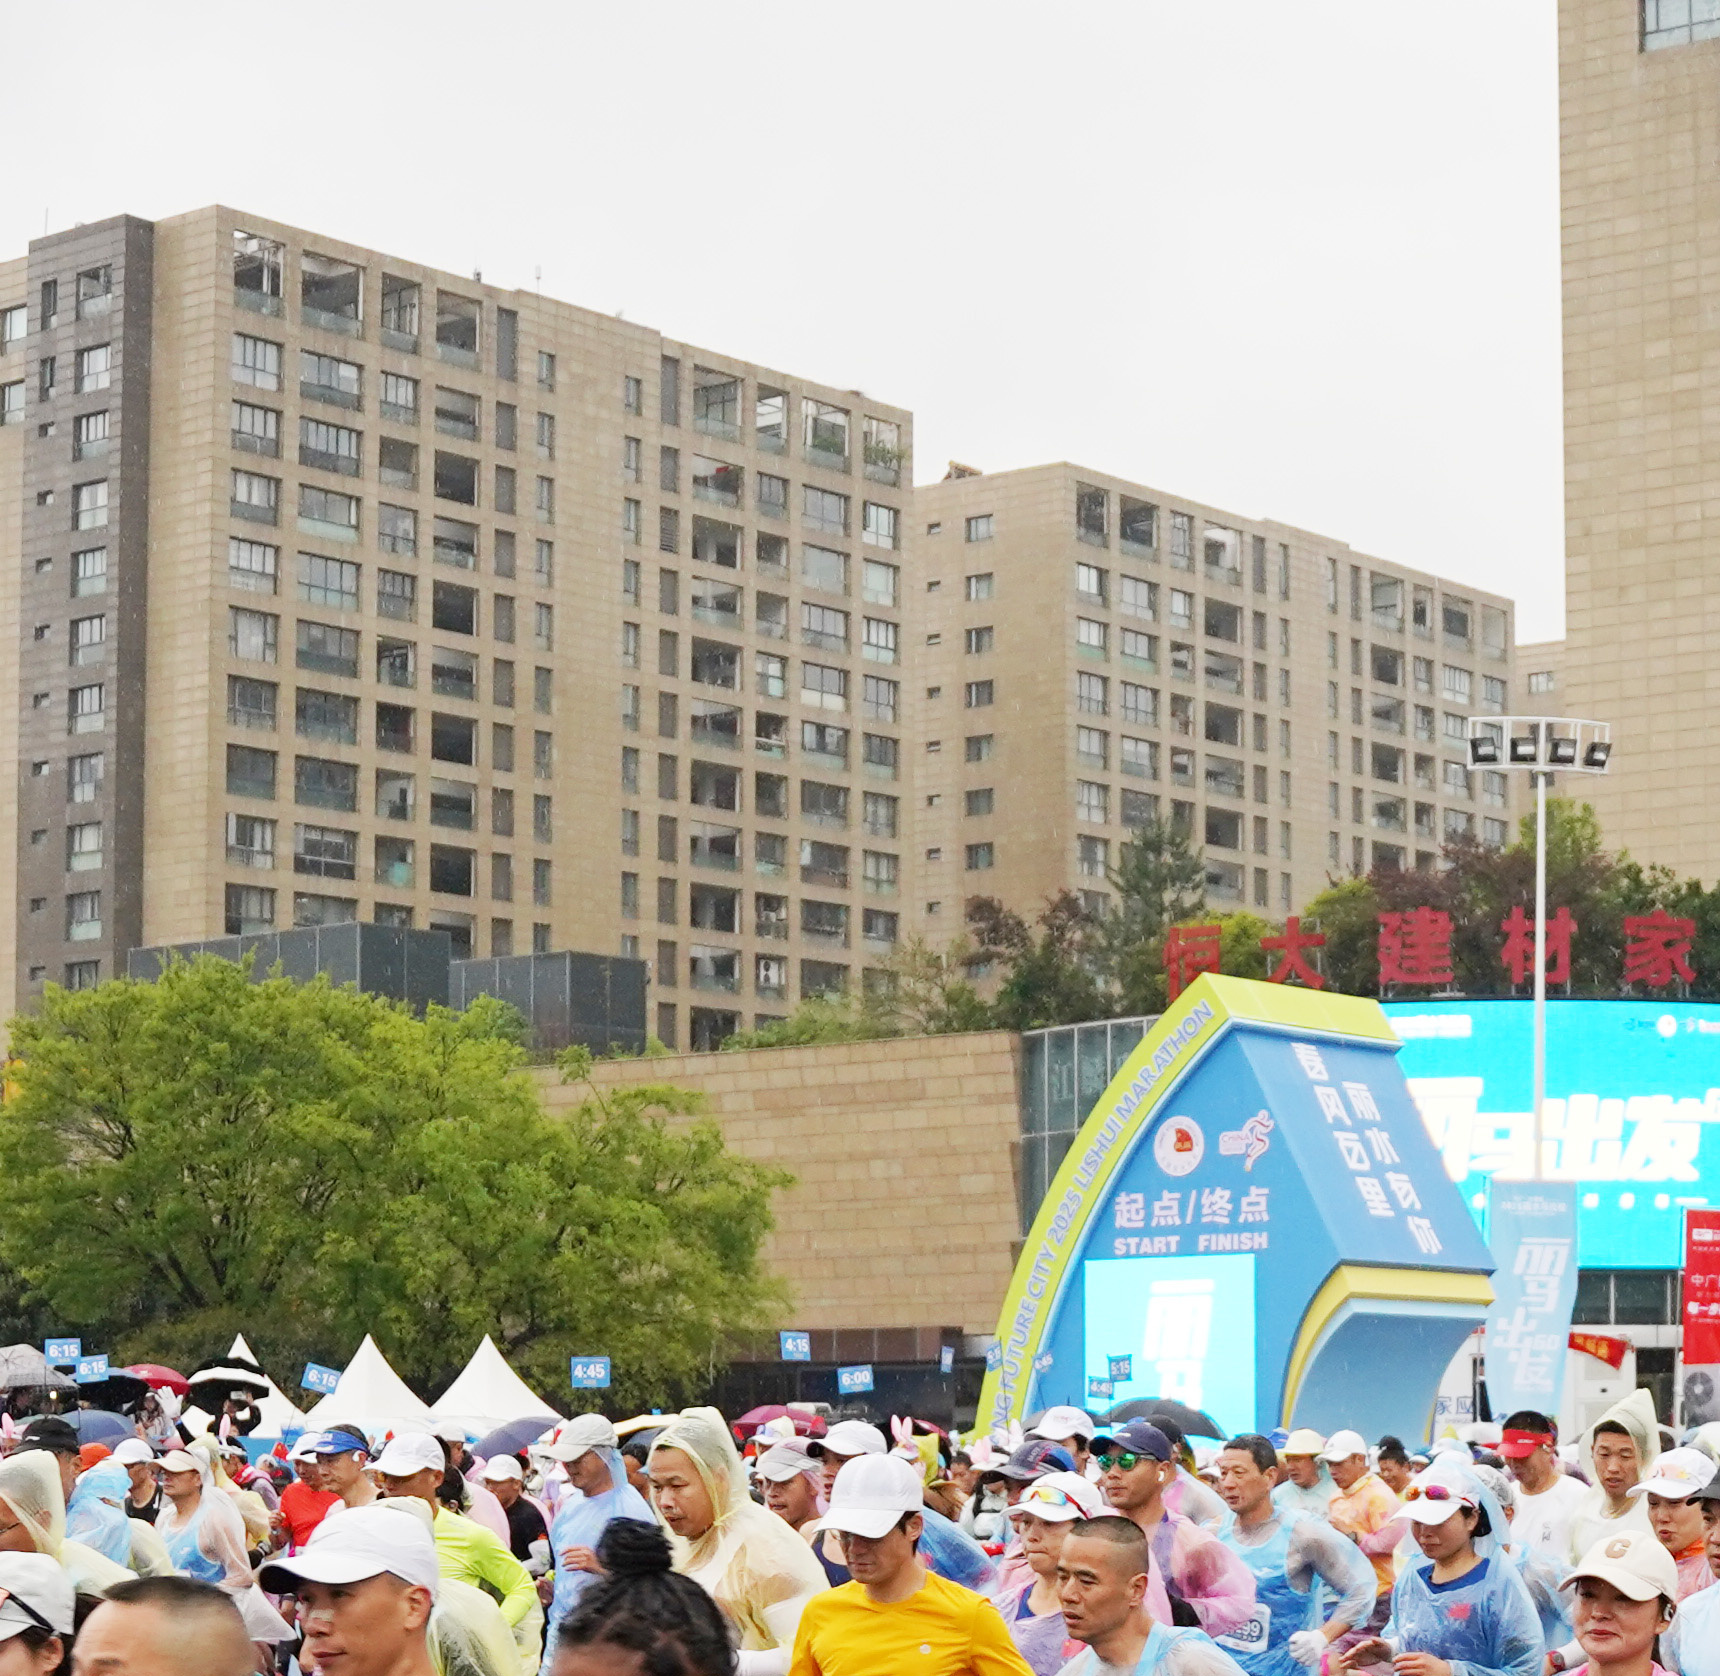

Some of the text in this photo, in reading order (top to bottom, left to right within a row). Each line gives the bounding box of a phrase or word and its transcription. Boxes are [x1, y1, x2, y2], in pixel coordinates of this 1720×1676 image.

[1342, 1081, 1443, 1254] 丽水有你
[1002, 1299, 1036, 1391] FUTURE
[1027, 1241, 1057, 1299] CITY
[1047, 1188, 1081, 1247] 2025
[1073, 1115, 1124, 1191] LISHUI
[1114, 1001, 1215, 1122] MARATHON
[1114, 1185, 1270, 1229] 起点/终点
[1114, 1232, 1268, 1255] START FINISH
[49, 1343, 79, 1358] 6:15
[784, 1337, 808, 1353] 4:15
[80, 1360, 107, 1375] 6:15
[574, 1363, 606, 1380] 4:45
[1111, 1360, 1130, 1374] 5:15
[308, 1369, 337, 1388] 6:15
[841, 1371, 870, 1387] 6:00
